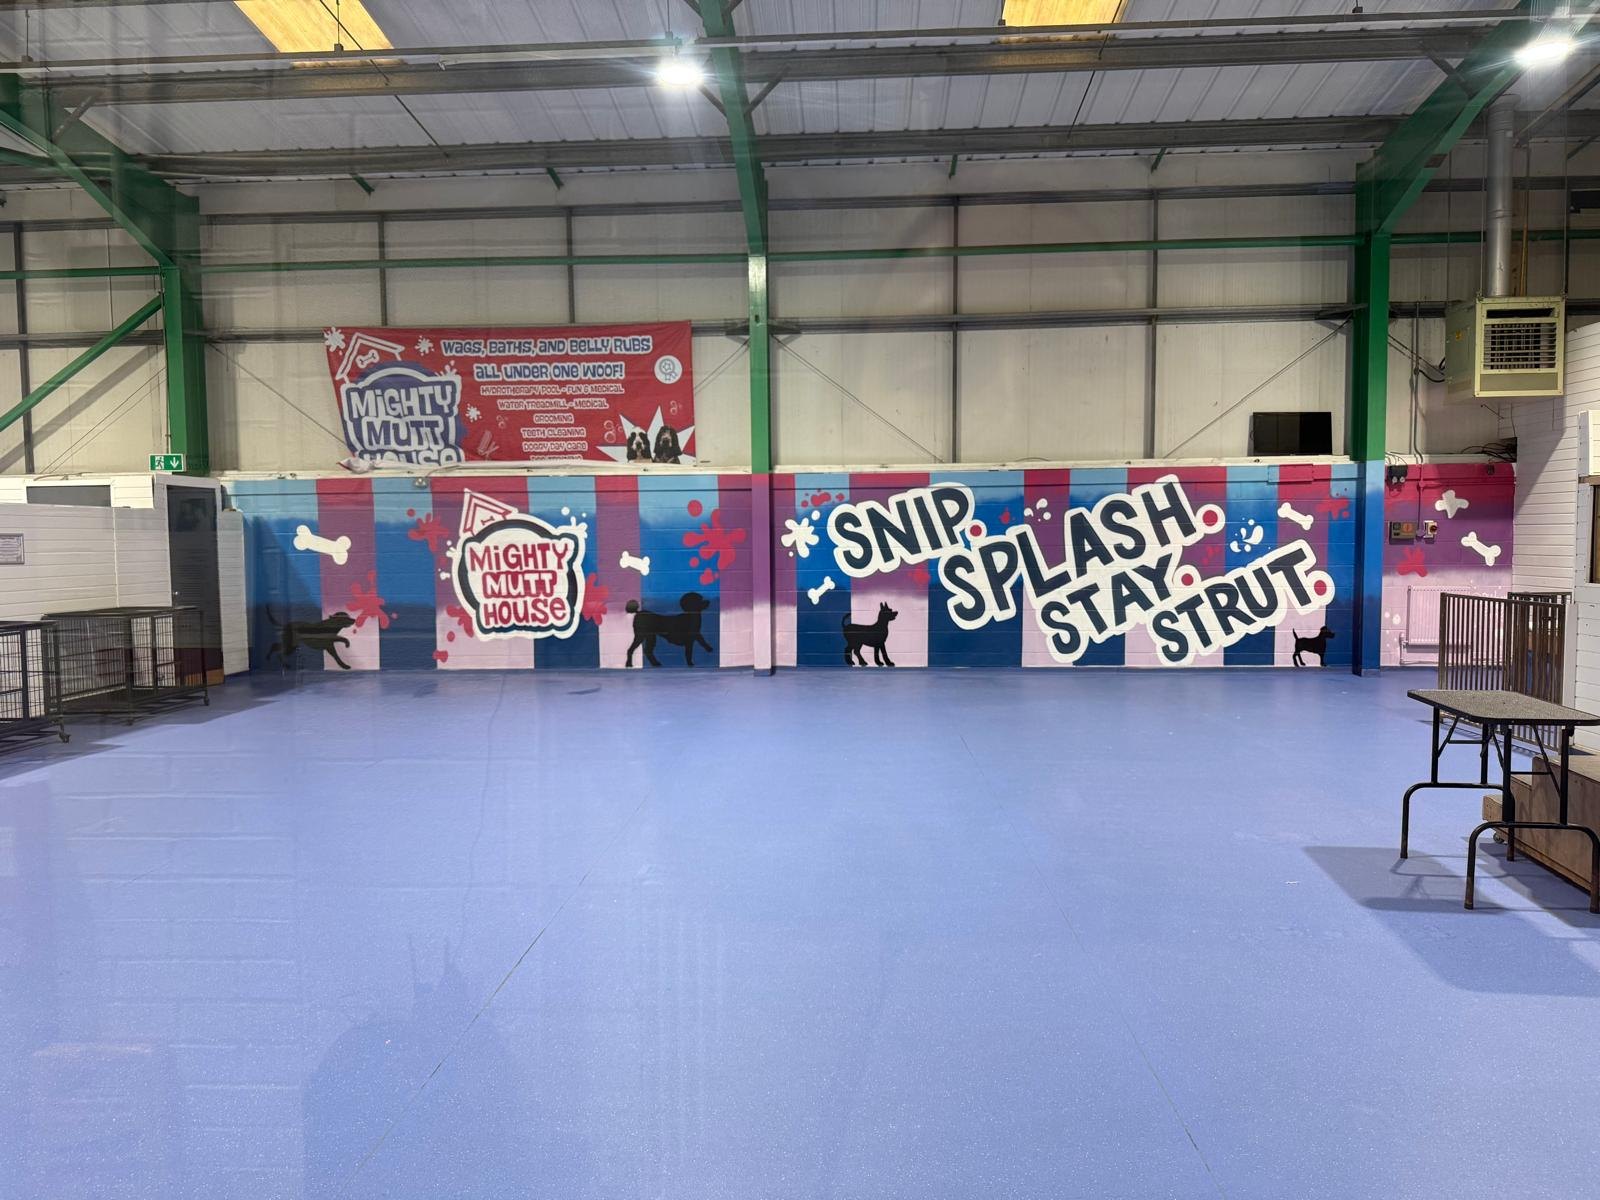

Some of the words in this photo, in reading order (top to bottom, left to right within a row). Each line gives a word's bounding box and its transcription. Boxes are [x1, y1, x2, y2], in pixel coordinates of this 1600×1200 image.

[613, 337, 652, 352] RUBS
[582, 363, 624, 378] WOOF!
[567, 385, 582, 393] FUN
[534, 414, 573, 423] GROOMING
[366, 420, 440, 447] MUTT
[834, 487, 983, 570] SNIP.
[469, 542, 569, 571] MiGHTY
[943, 481, 1219, 622] SPLASH.
[484, 572, 555, 597] MUTT
[483, 597, 567, 626] HOUSe
[1040, 552, 1194, 655] STAY.
[1152, 547, 1328, 663] STRUT.
